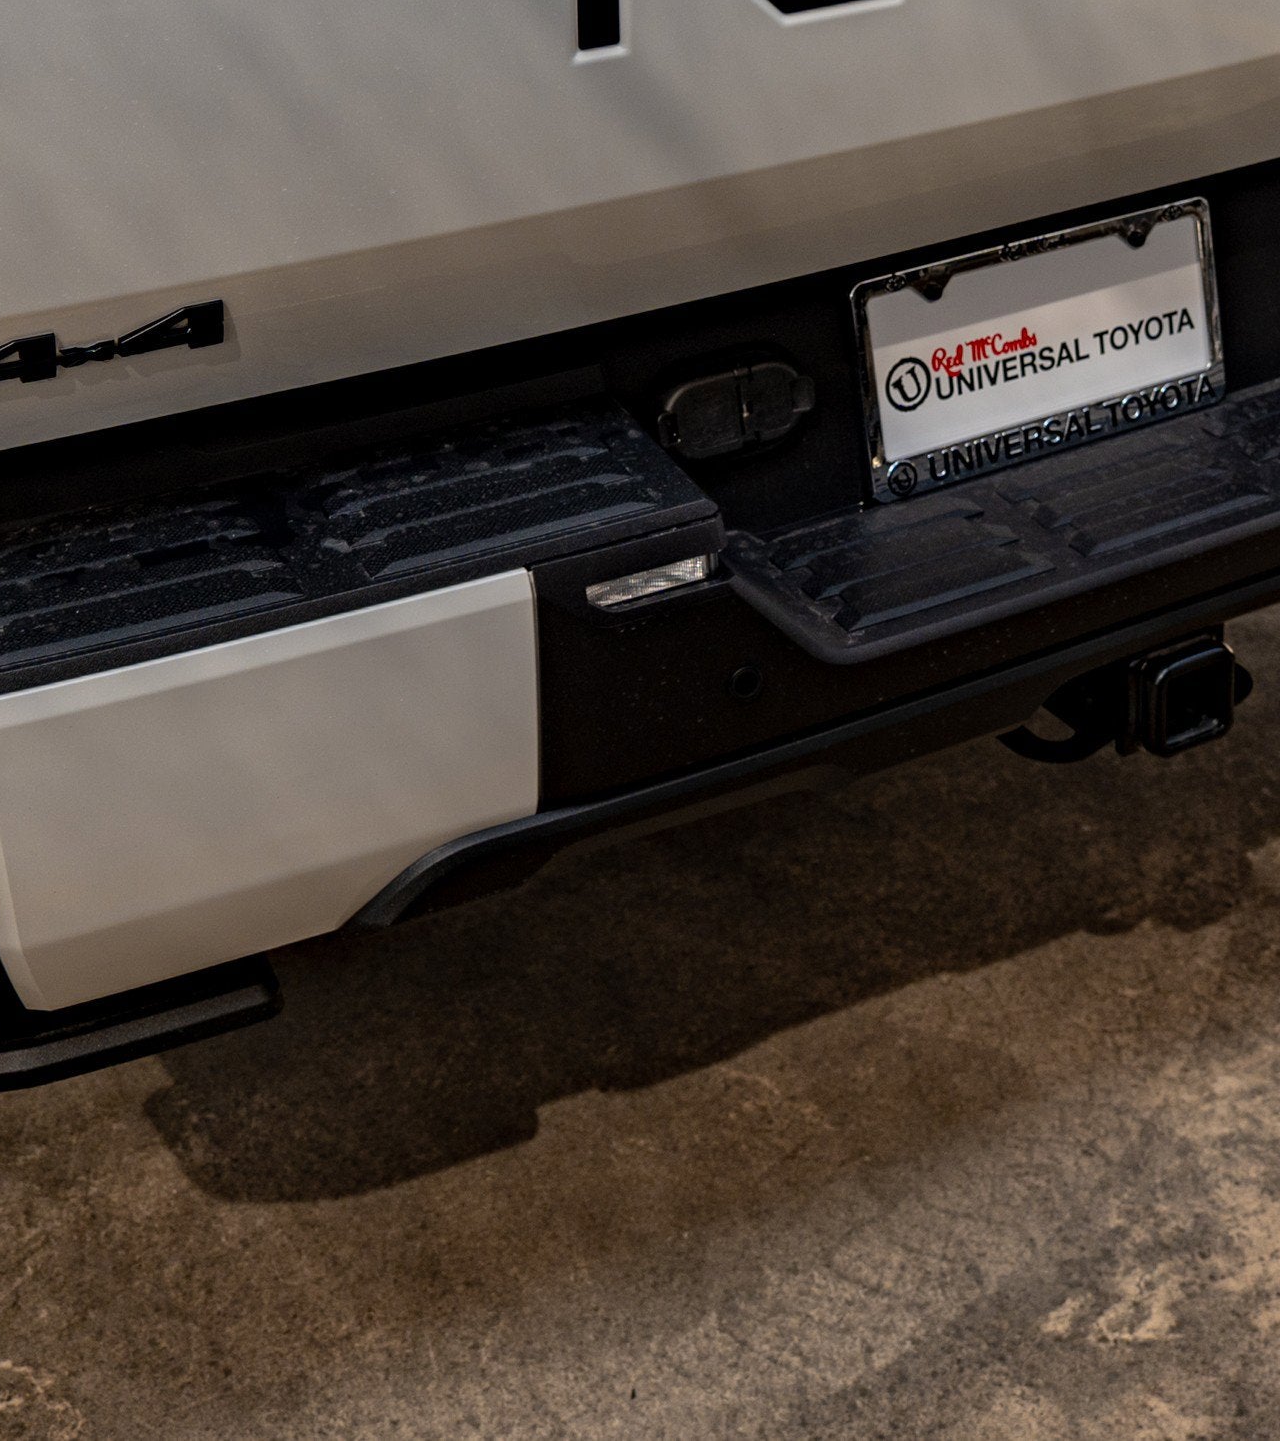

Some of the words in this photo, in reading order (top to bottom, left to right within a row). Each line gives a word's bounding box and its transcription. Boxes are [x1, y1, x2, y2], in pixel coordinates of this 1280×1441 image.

[931, 344, 964, 377] Red
[935, 336, 1090, 400] UNIVERSAL
[1094, 308, 1195, 355] TOYOTA
[928, 407, 1103, 482] UNIVERSAL
[1103, 374, 1217, 429] TOYOTA
